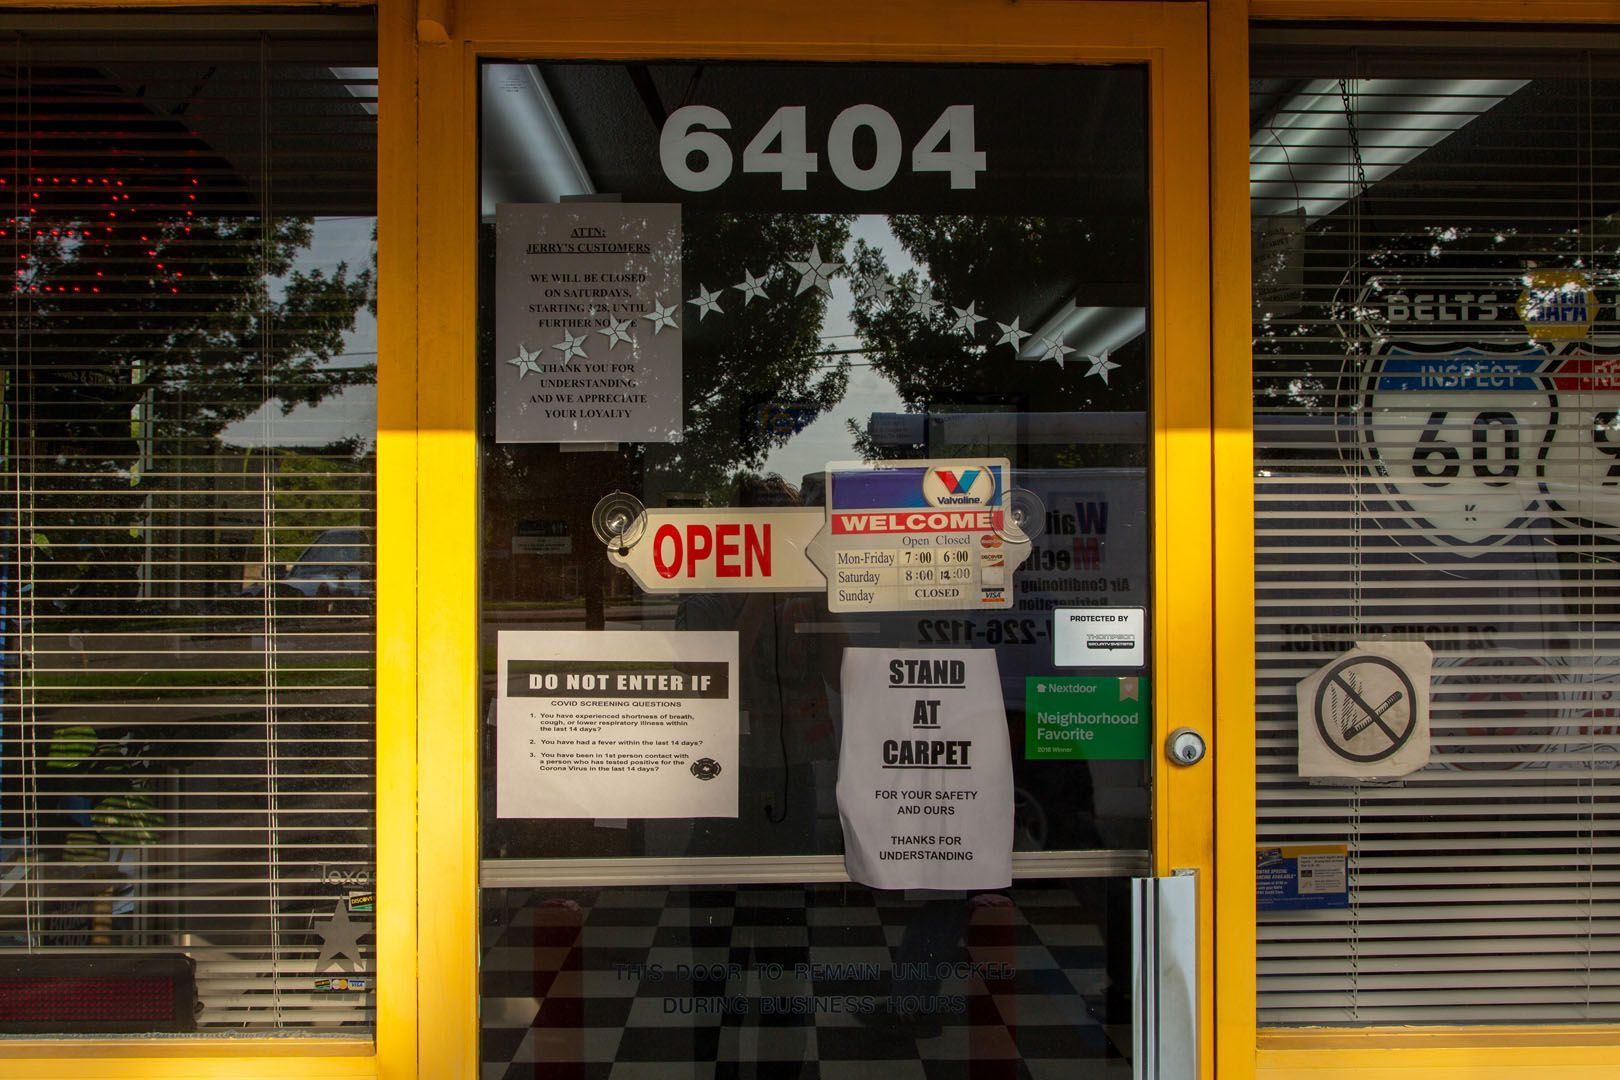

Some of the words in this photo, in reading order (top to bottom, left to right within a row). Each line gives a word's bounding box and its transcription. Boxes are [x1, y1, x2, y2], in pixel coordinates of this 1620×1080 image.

[660, 104, 986, 192] 6404
[571, 228, 606, 238] ATTN:
[526, 243, 575, 254] JERRY'S
[578, 243, 650, 254] CUSTOMERS
[530, 274, 548, 283] WE
[551, 274, 581, 283] WILL
[584, 274, 598, 283] BE
[600, 274, 646, 283] CLOSED
[544, 289, 560, 298] ON
[564, 289, 632, 298] SATURDAYS,
[529, 304, 585, 313] STARTING
[612, 304, 647, 312] UNTIL
[1387, 294, 1498, 321] BELTS
[538, 319, 592, 328] FURTHER
[542, 364, 582, 373] THANK
[585, 364, 609, 373] YOU
[612, 364, 634, 373] FOR
[1420, 364, 1520, 388] INSPECT
[540, 379, 637, 388] UNDERSTANDING
[529, 394, 553, 404] AND
[556, 394, 574, 404] WE
[576, 394, 647, 404] APPRECIATE
[544, 410, 577, 419] YOUR
[580, 410, 632, 419] LOYALTY
[1412, 410, 1520, 487] 60
[937, 496, 980, 505] Valvoline
[840, 512, 996, 532] WELCOME
[902, 536, 930, 548] Open
[936, 534, 970, 546] Closed
[652, 523, 772, 580] OPEN
[838, 552, 895, 566] Mon-Friday
[838, 570, 880, 585] Saturday
[838, 590, 874, 603] Sunday
[914, 588, 960, 598] CLOSED
[889, 660, 966, 685] STAND
[529, 674, 558, 690] DO
[567, 674, 609, 690] NOT
[617, 675, 684, 691] ENTER
[692, 676, 711, 691] IF
[1049, 684, 1096, 693] Nextdoor
[913, 700, 941, 725] AT
[1037, 712, 1139, 726] Neighborhood
[1037, 728, 1094, 740] Favorite
[883, 740, 972, 765] CARPET
[875, 790, 898, 800] FOR
[901, 791, 932, 800] YOUR
[935, 791, 978, 800] SAFETY
[897, 806, 920, 815] AND
[924, 806, 954, 815] OURS
[891, 836, 935, 845] THANKS
[939, 836, 961, 845] FOR
[880, 851, 973, 861] UNDERSTANDING
[319, 863, 376, 886] Texa
[352, 895, 376, 904] DISCOVE
[616, 962, 664, 982] THIS
[676, 962, 741, 982] DOOR
[752, 962, 784, 982] TO
[795, 962, 880, 982] REMAIN
[892, 962, 1016, 982] UNLOCKED
[662, 996, 748, 1015] DURING
[760, 996, 875, 1015] BUSINESS
[886, 996, 967, 1015] HOURS
